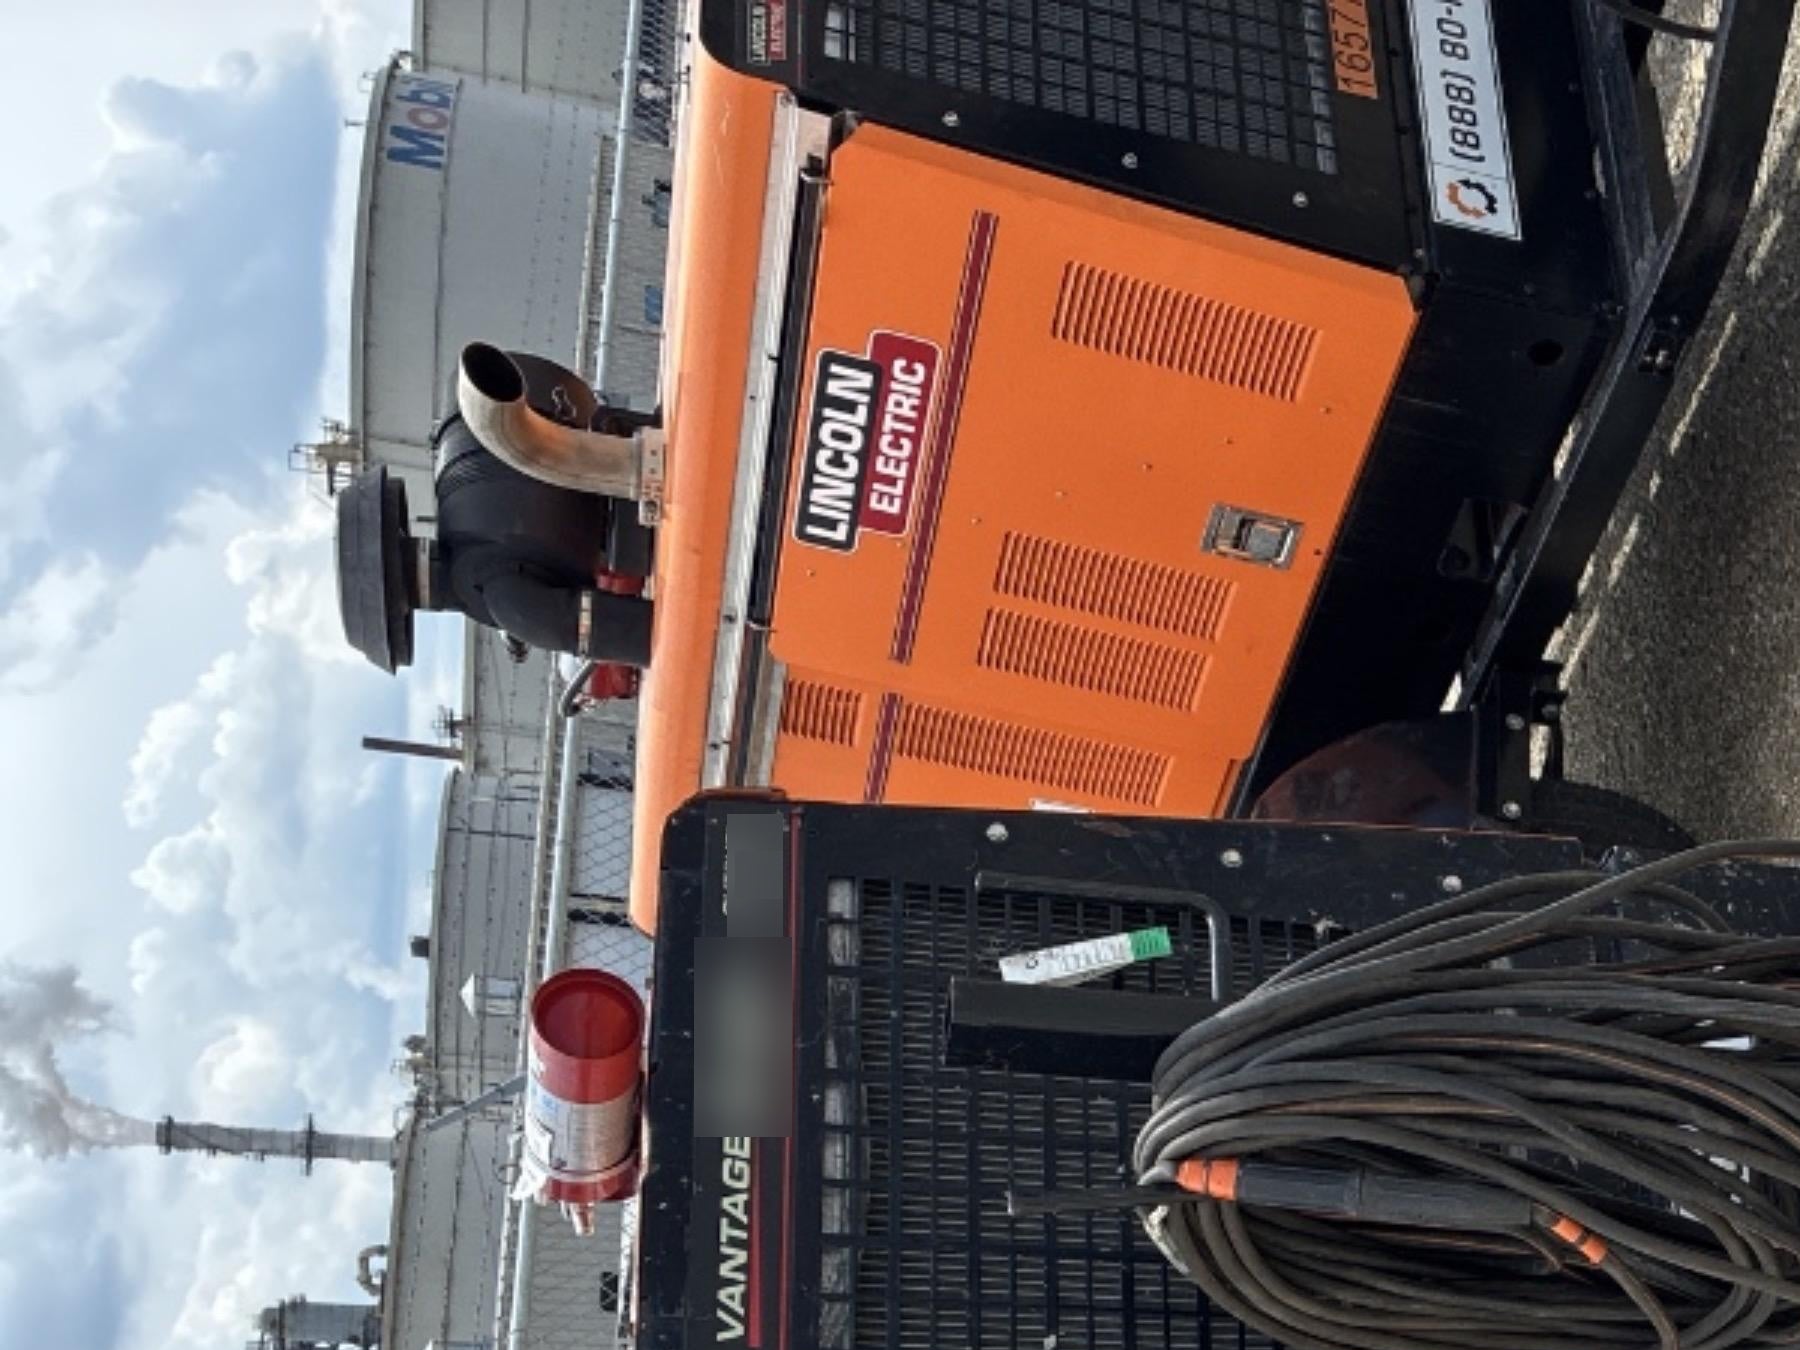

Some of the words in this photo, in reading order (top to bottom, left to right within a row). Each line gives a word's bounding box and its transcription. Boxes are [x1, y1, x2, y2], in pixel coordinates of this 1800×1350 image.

[1435, 0, 1470, 60] 80-
[1440, 69, 1486, 163] (888)
[805, 363, 875, 541] LINCOLN
[868, 358, 926, 514] ELECTRIC
[716, 1137, 751, 1342] VANTAGE
